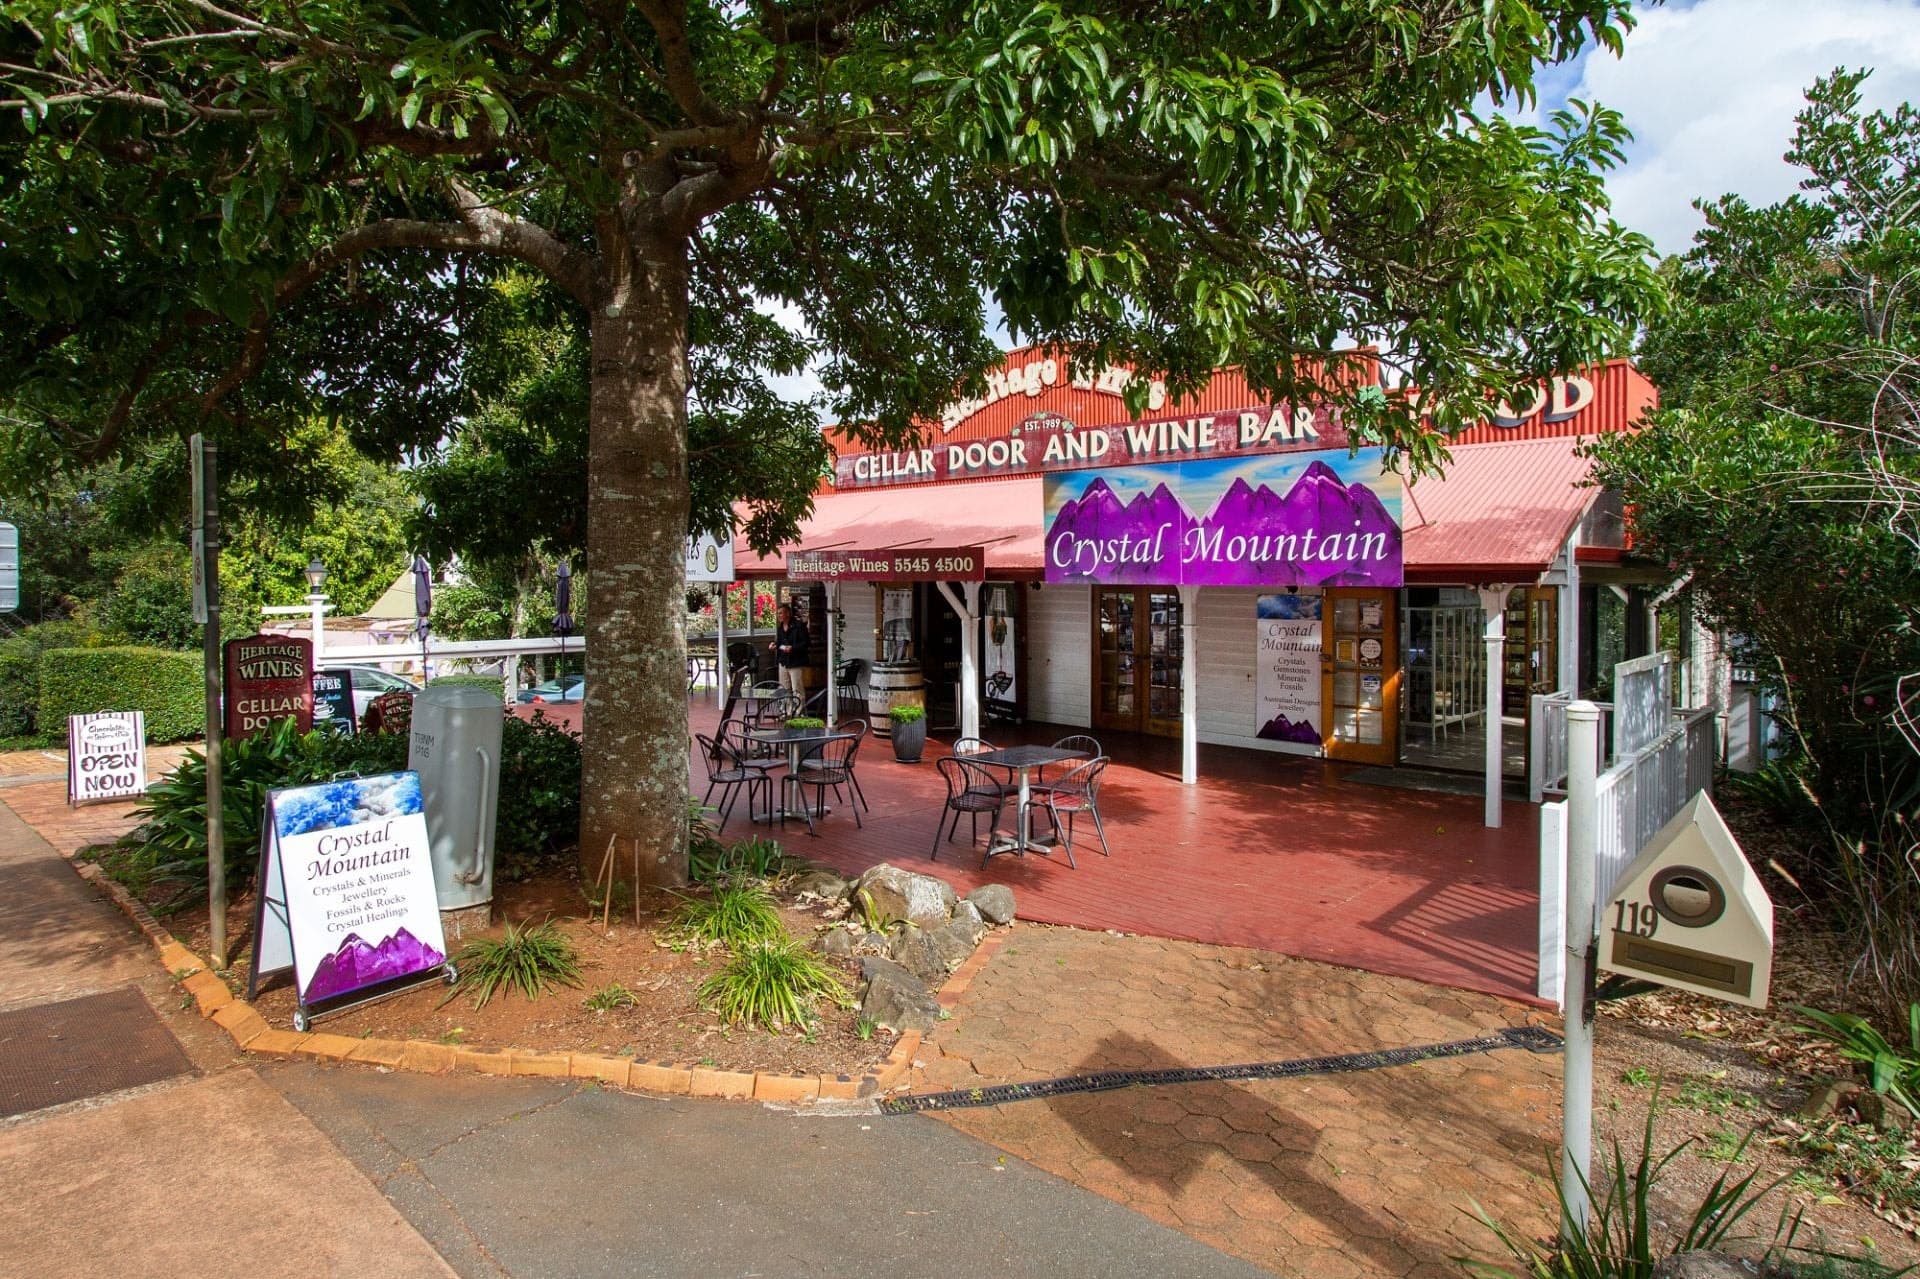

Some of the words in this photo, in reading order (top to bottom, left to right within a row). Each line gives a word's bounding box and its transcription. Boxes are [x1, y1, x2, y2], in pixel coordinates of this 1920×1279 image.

[1024, 420, 1041, 431] EST.
[1042, 419, 1061, 429] 1989
[854, 449, 936, 478] CELLAR
[948, 438, 1028, 470] DOOR
[1041, 430, 1110, 461] AND
[1127, 416, 1218, 453] WINE
[1239, 406, 1320, 443] BAR
[1052, 522, 1173, 576] Crystal
[1183, 519, 1388, 564] Mountain
[794, 559, 845, 576] Heritage
[848, 558, 889, 573] Wines
[894, 557, 930, 573] 5545
[934, 556, 974, 572] 4500
[1269, 624, 1316, 640] Crystal
[240, 644, 303, 661] HERITAGE
[1262, 638, 1323, 653] Mountain
[239, 660, 304, 680] WINES
[1273, 665, 1310, 675] Gemstones
[1278, 657, 1306, 667] Crystals
[313, 678, 341, 691] FFEE
[1277, 673, 1307, 683] Minerals
[1280, 682, 1304, 692] Fossils
[237, 697, 305, 715] CELLAR
[243, 714, 298, 731] DO
[81, 752, 137, 772] OPEN
[85, 772, 135, 792] NOW
[317, 820, 393, 857] Crystal
[307, 843, 410, 881] Mountain
[312, 877, 354, 897] Crystals
[357, 877, 366, 887] &
[369, 868, 411, 884] Minerals
[341, 886, 388, 903] Jewellery
[326, 904, 361, 920] Fossils
[364, 901, 373, 910] &
[376, 894, 406, 908] Rocks
[327, 914, 364, 932] Crystal
[366, 906, 409, 923] Healings
[1611, 899, 1659, 938] 119
